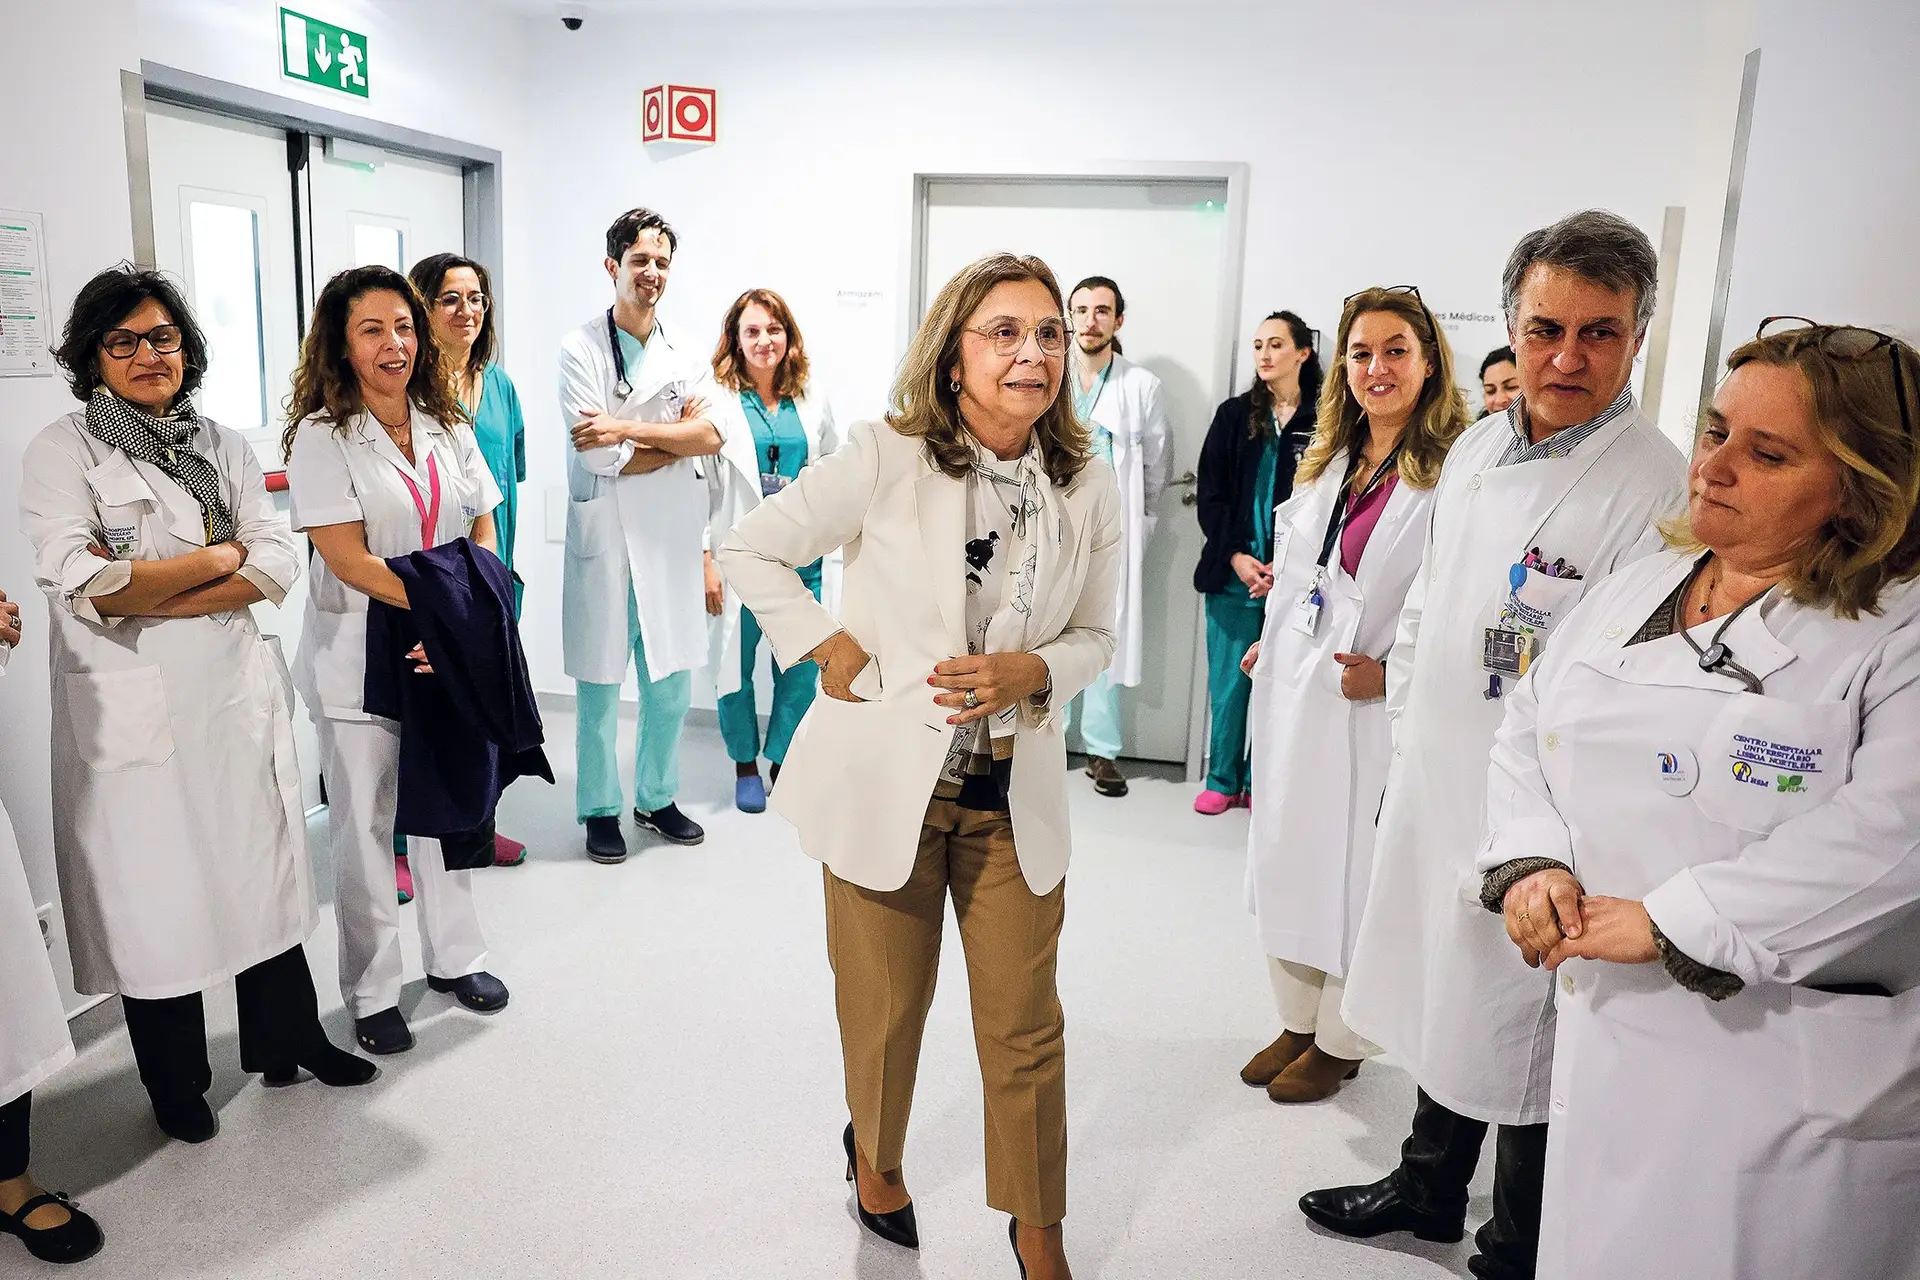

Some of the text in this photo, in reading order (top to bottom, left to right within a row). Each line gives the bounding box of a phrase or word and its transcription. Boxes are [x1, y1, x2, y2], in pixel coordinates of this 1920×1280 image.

[1449, 312, 1496, 322] Médicos
[1733, 733, 1823, 756] CENTRO HOSPITALAR
[1736, 749, 1766, 762] LISBOA
[1743, 744, 1812, 763] UNIVERSITÁRIO
